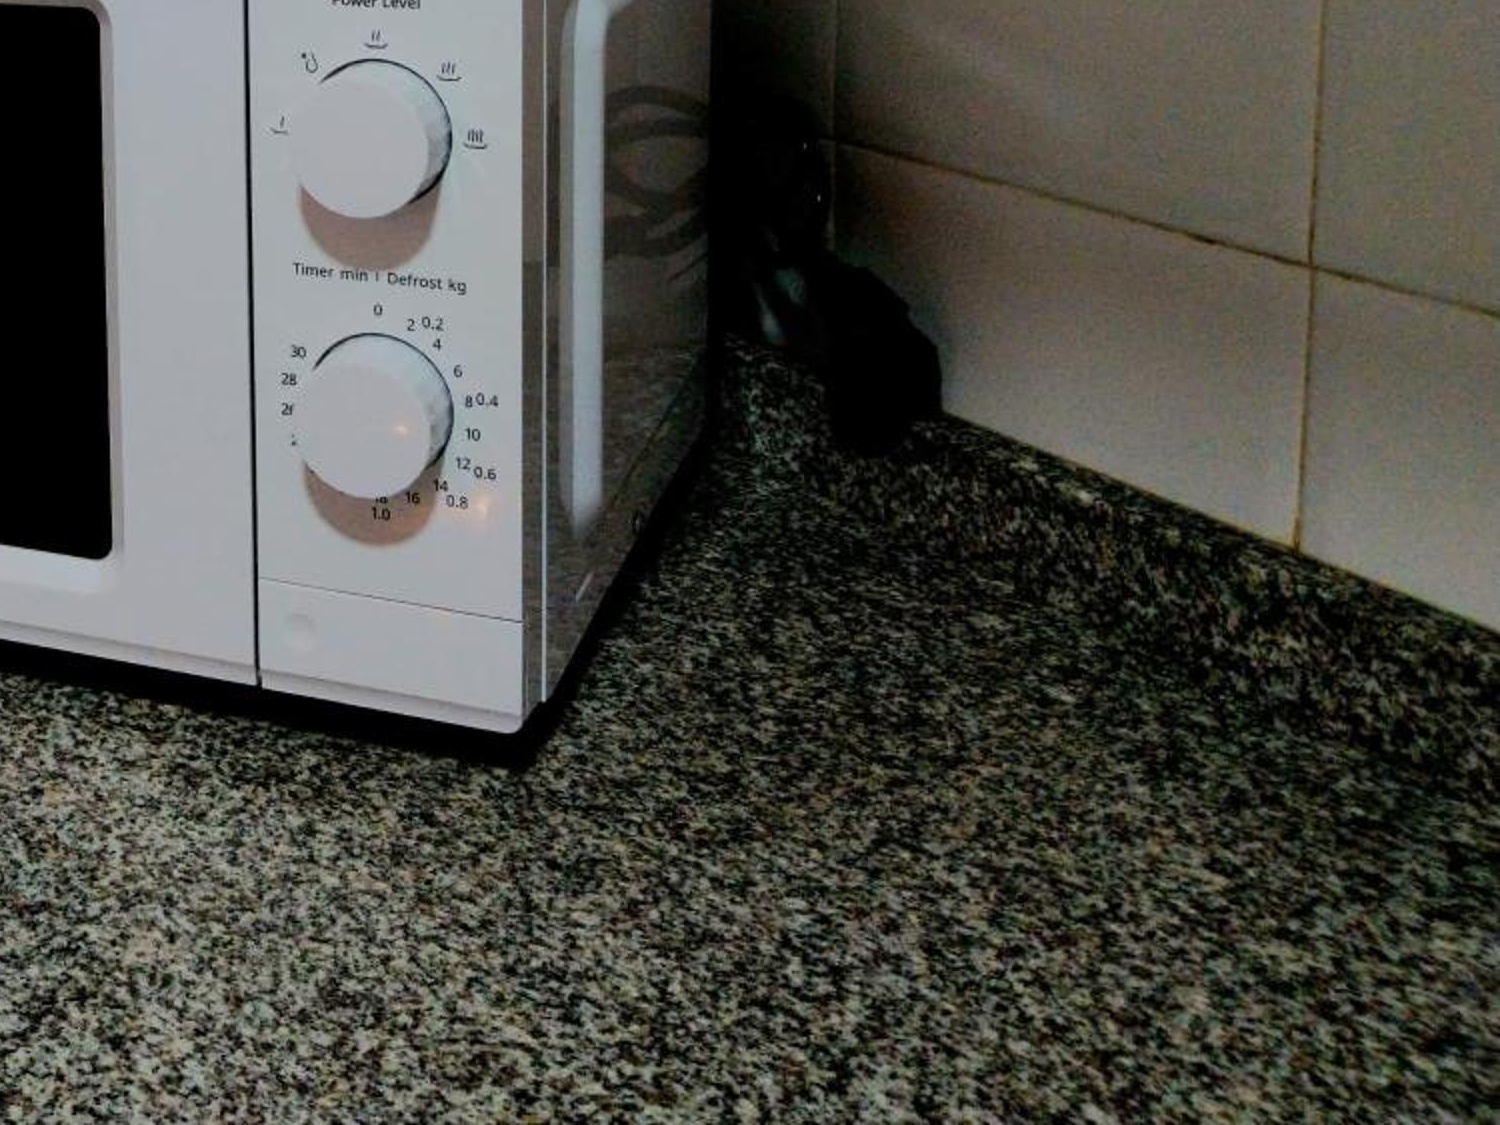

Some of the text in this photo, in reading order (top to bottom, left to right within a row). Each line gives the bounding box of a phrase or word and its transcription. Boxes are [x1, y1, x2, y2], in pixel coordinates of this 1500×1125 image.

[293, 262, 334, 279] Timer
[340, 267, 369, 282] min
[387, 271, 443, 290] Defrost
[447, 278, 467, 296] kg
[373, 303, 383, 316] 0
[406, 318, 416, 332] 2
[421, 315, 444, 332] 0.2
[291, 344, 307, 360] 30
[432, 338, 442, 351] 4
[281, 372, 298, 386] 28
[453, 364, 463, 379] 6
[464, 395, 474, 408] 8
[475, 392, 499, 408] 0.4
[465, 427, 481, 442] 10
[455, 456, 471, 471] 12
[473, 466, 497, 481] 0.6
[433, 477, 449, 492] 14
[405, 490, 421, 504] 16
[445, 494, 469, 510] 0.8
[371, 506, 391, 521] 1.0
